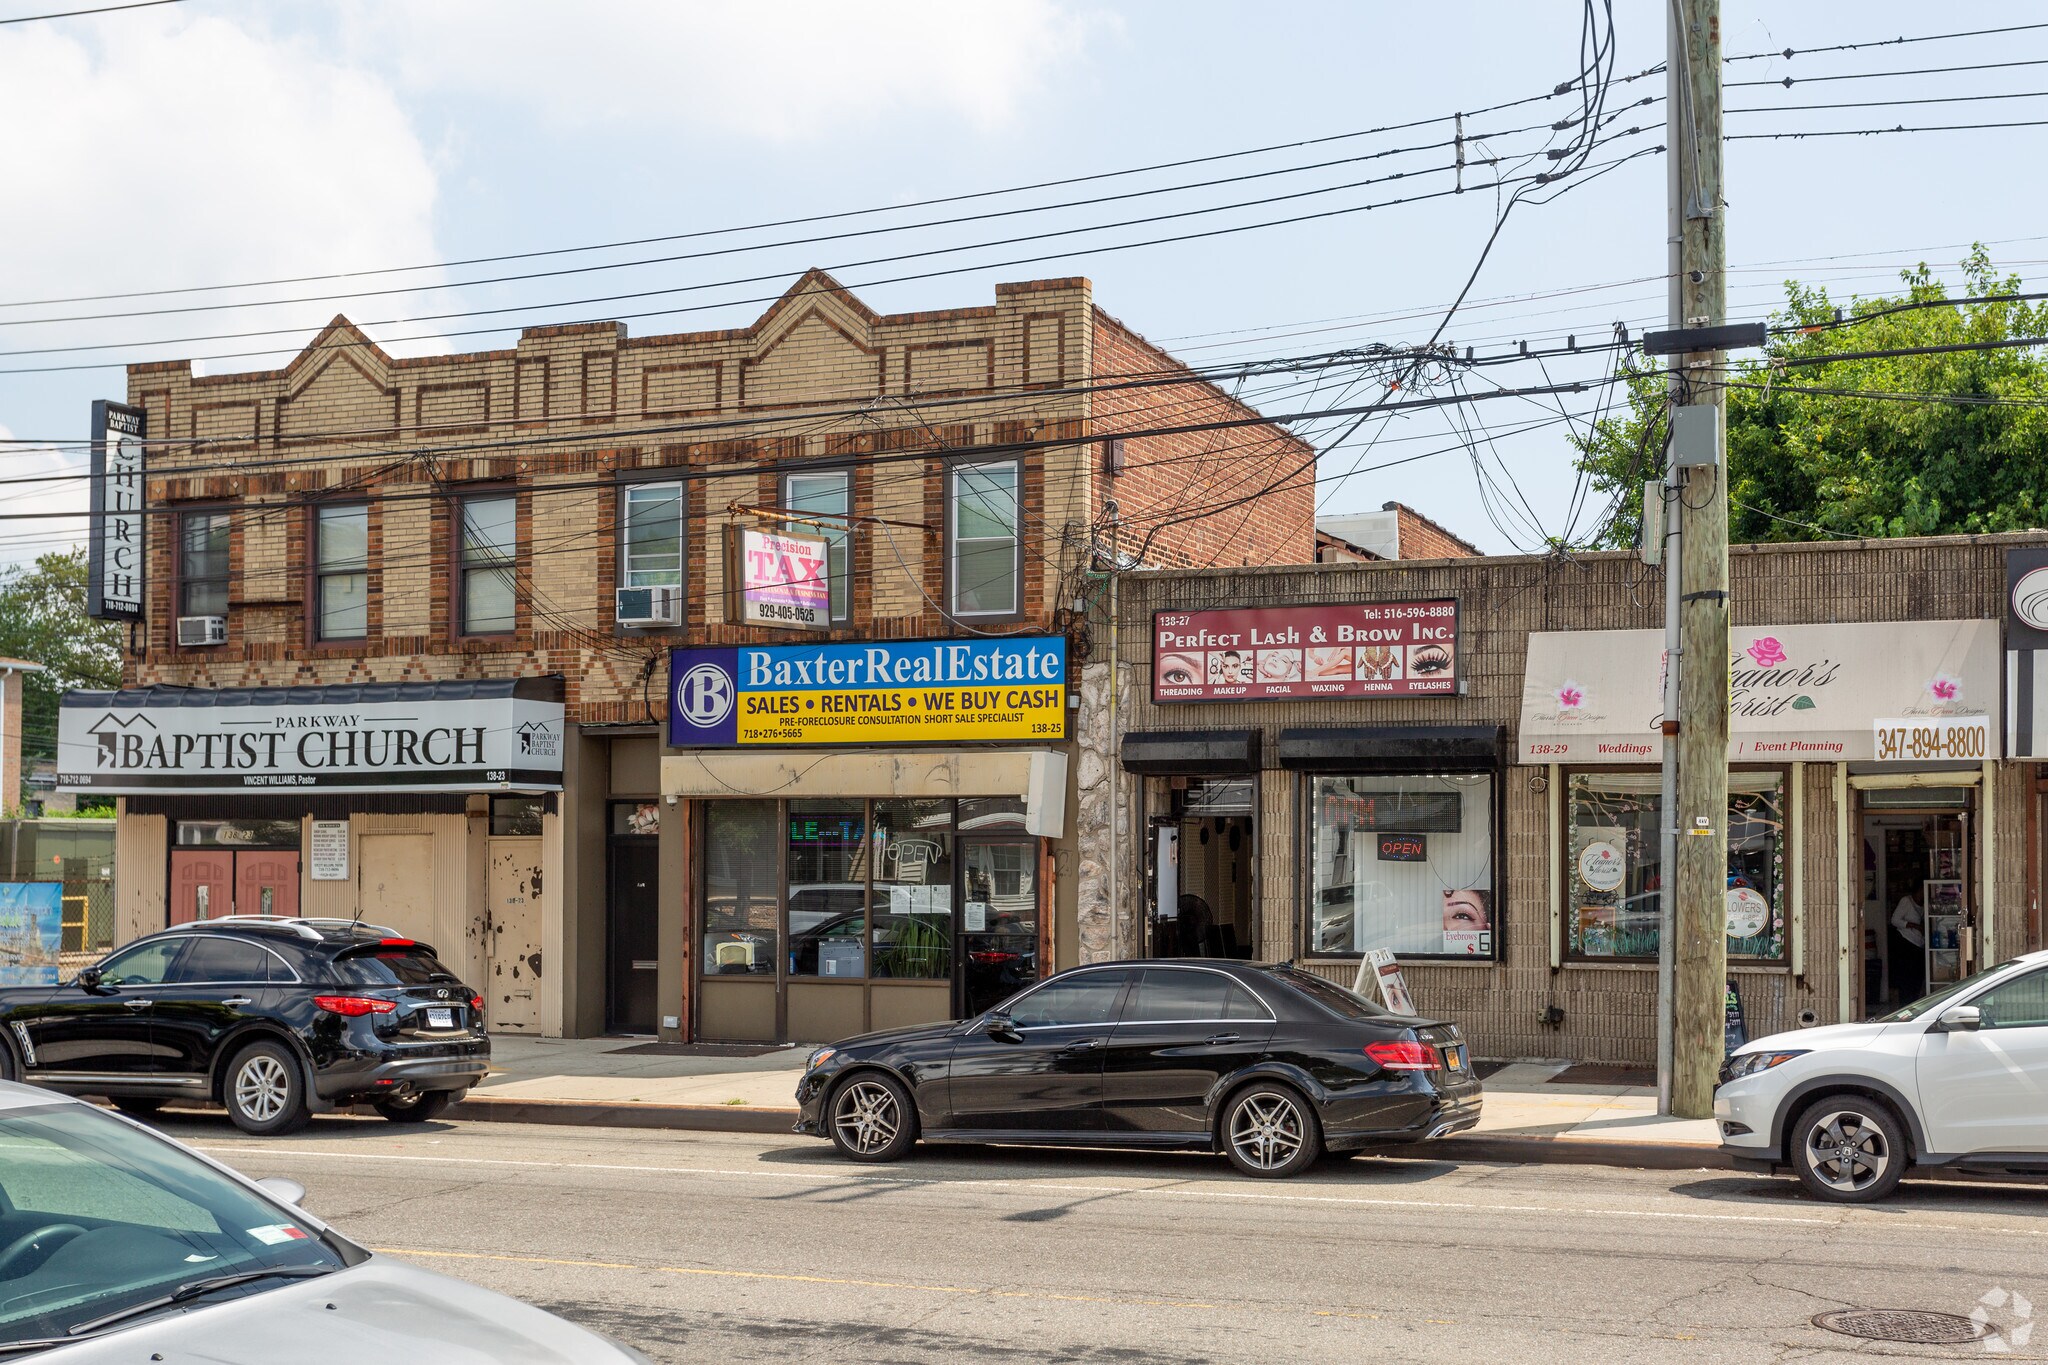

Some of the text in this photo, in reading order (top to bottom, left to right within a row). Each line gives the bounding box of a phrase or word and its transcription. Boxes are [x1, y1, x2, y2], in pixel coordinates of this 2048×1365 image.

[108, 410, 140, 426] PARKWAY
[109, 418, 139, 434] BAPTIST
[111, 437, 135, 599] CHURCH
[762, 535, 812, 556] Precision
[748, 549, 826, 588] TAX
[759, 603, 815, 622] 929-405-0525
[1364, 606, 1454, 620] Tel: 516-596-8880
[1160, 616, 1190, 627] 138-27
[1309, 625, 1328, 643] &
[1159, 688, 1203, 696] THREADING
[1213, 686, 1247, 695] MAKE UP
[1265, 685, 1292, 693] FACIAL
[1311, 684, 1345, 692] WAXING
[1364, 683, 1393, 691] HENNA
[1408, 682, 1451, 690] EYELASHES
[746, 690, 1059, 715] SALES RENTALS WE BUY CASH
[275, 714, 361, 729] PARKWAY
[779, 712, 1024, 727] PRE-FORECLOSURE CONSULTATION SHORT SALE SPECIALIST
[1031, 723, 1062, 733] 138-25
[531, 732, 561, 742] PARKWAY
[1878, 725, 1985, 760] 347-894-8800
[120, 727, 487, 769] BAPTIST CHURCH
[531, 740, 556, 749] BAPTIST
[1529, 740, 1844, 756] 138-29 Weddings Event Planning
[531, 747, 557, 757] CHURCH
[243, 775, 317, 786] VINCENT WILLIAMS, Pastor
[486, 770, 506, 781] 138-23
[887, 842, 939, 865] OPEN
[1381, 842, 1422, 855] OPEN
[1727, 902, 1762, 914] LOWERS
[1445, 931, 1478, 943] Eyebrows
